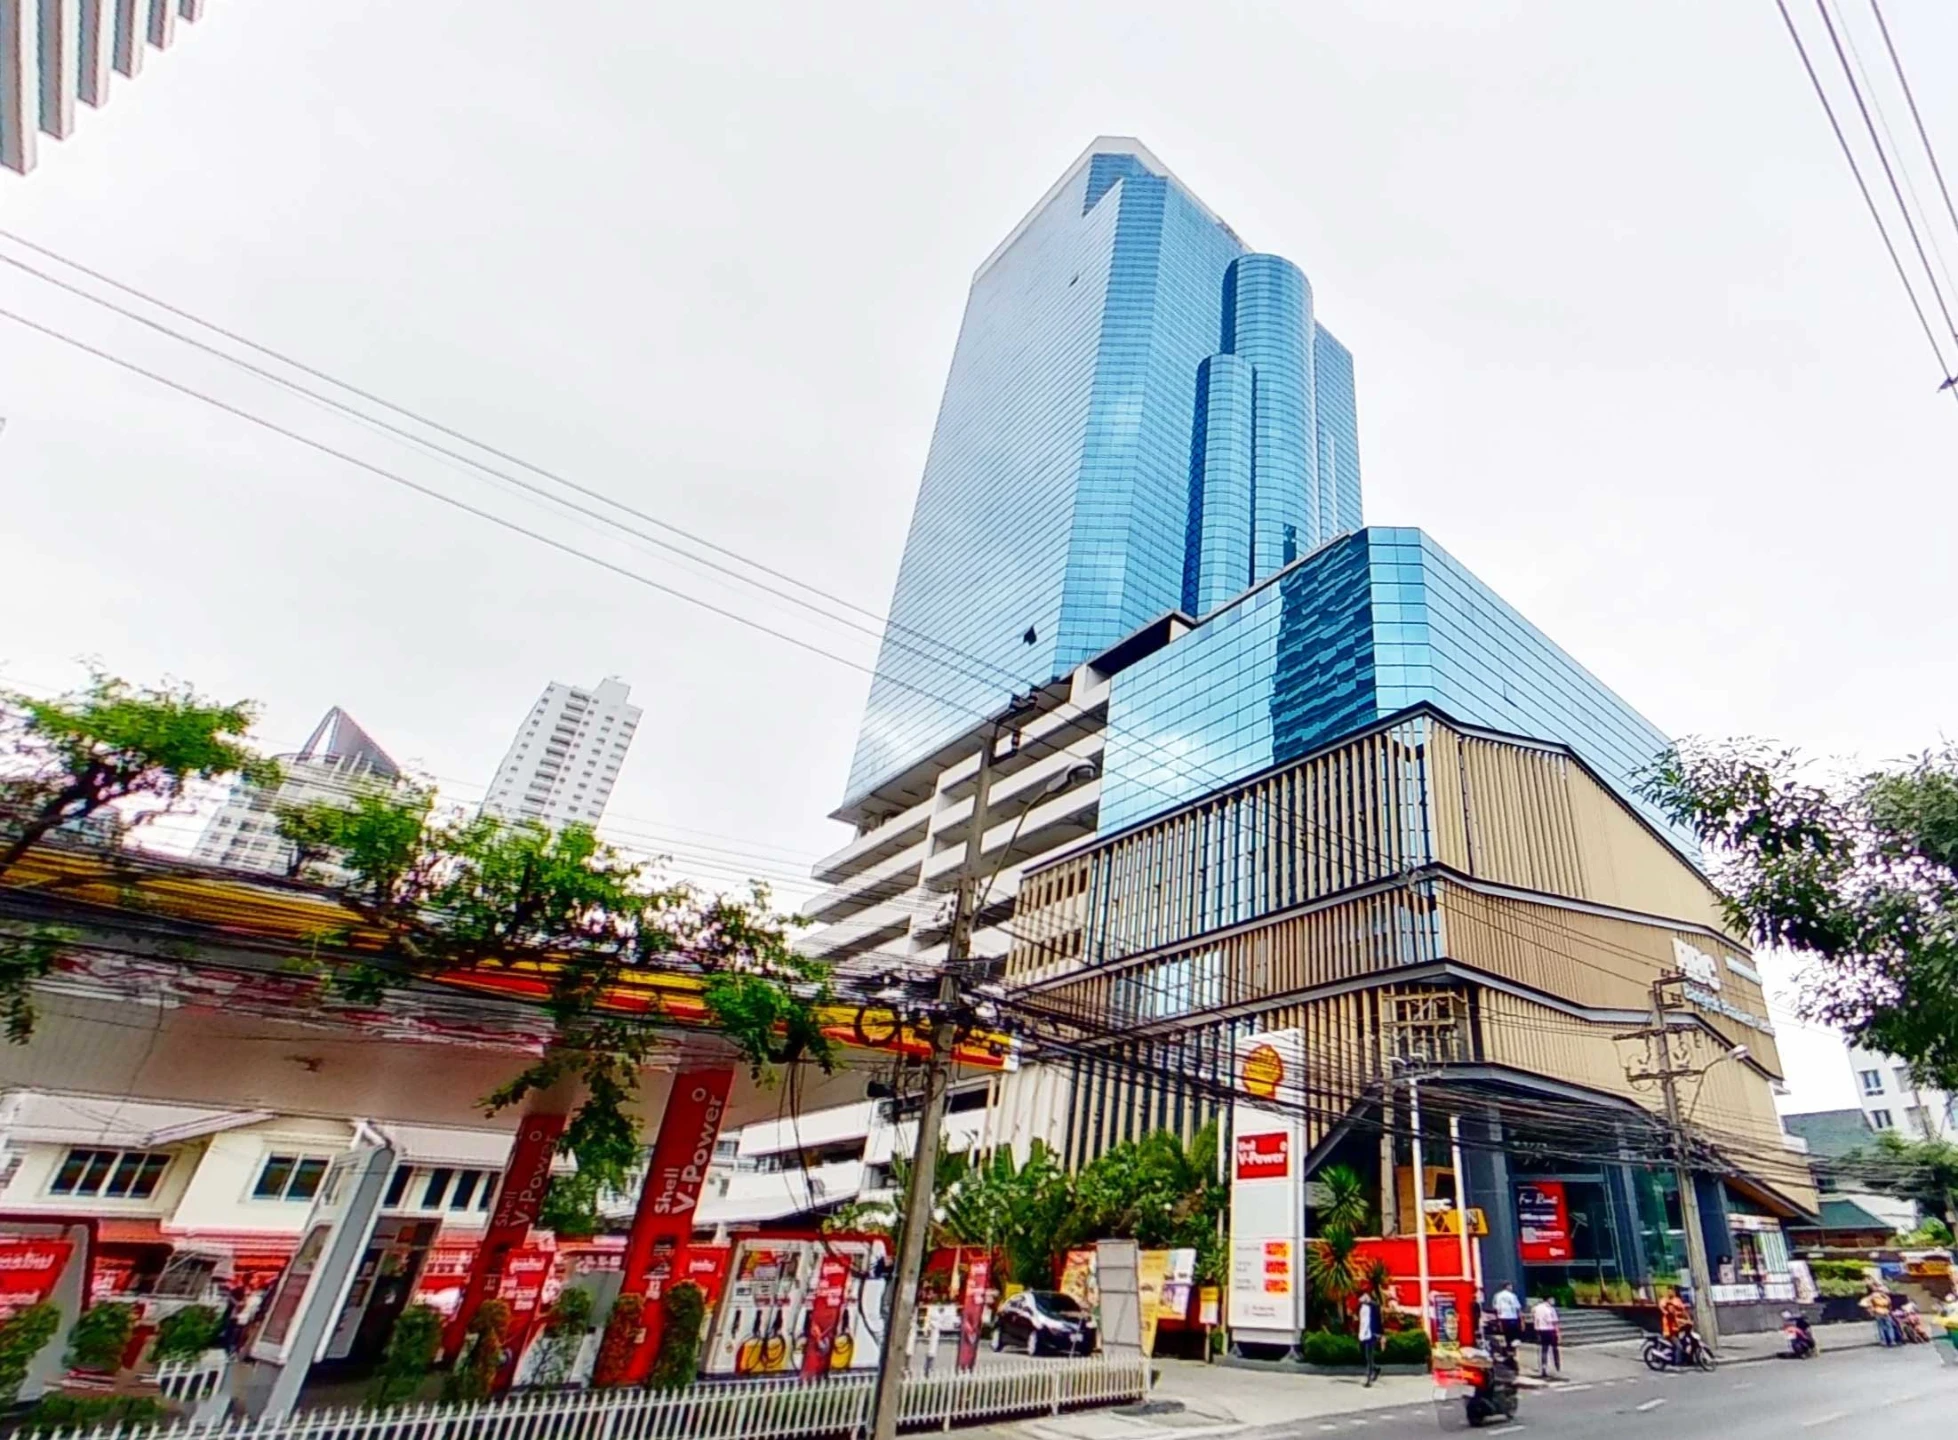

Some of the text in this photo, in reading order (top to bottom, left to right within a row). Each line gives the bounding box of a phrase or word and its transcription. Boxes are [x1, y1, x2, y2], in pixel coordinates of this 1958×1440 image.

[671, 1095, 722, 1214] V-Power
[1237, 1151, 1286, 1166] V-Power
[509, 1134, 556, 1227] V-Power
[654, 1168, 680, 1214] Shell
[495, 1191, 518, 1227] Shell
